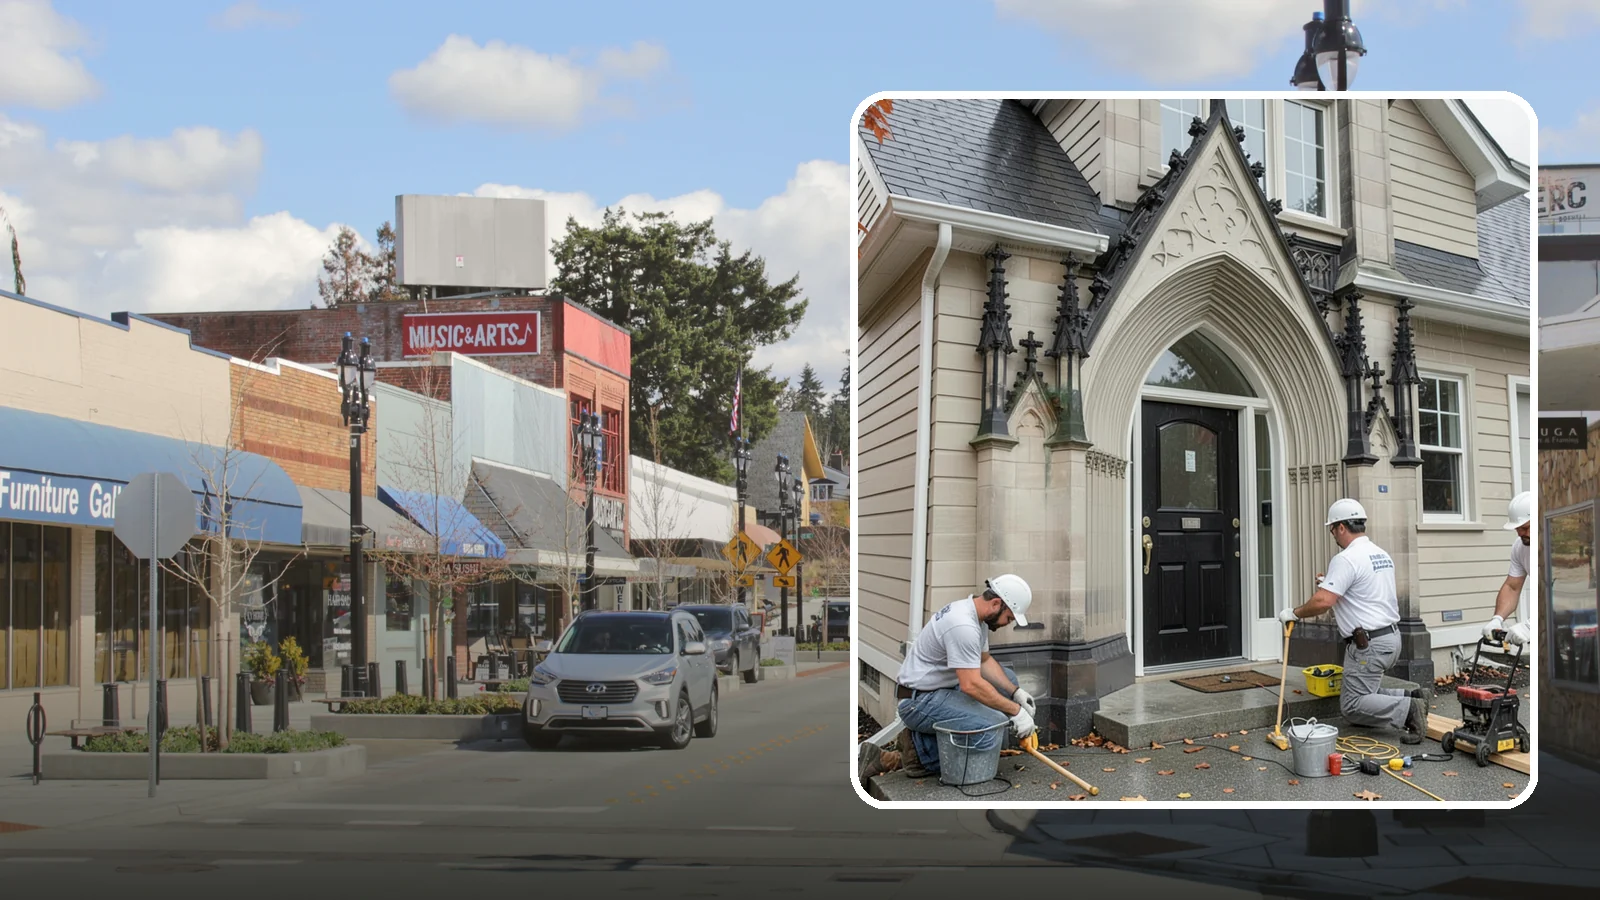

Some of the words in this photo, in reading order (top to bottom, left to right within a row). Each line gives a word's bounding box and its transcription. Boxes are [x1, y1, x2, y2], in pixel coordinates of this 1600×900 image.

[1540, 428, 1577, 436] UGA
[0, 472, 79, 515] Furniture
[90, 482, 121, 519] Gal
